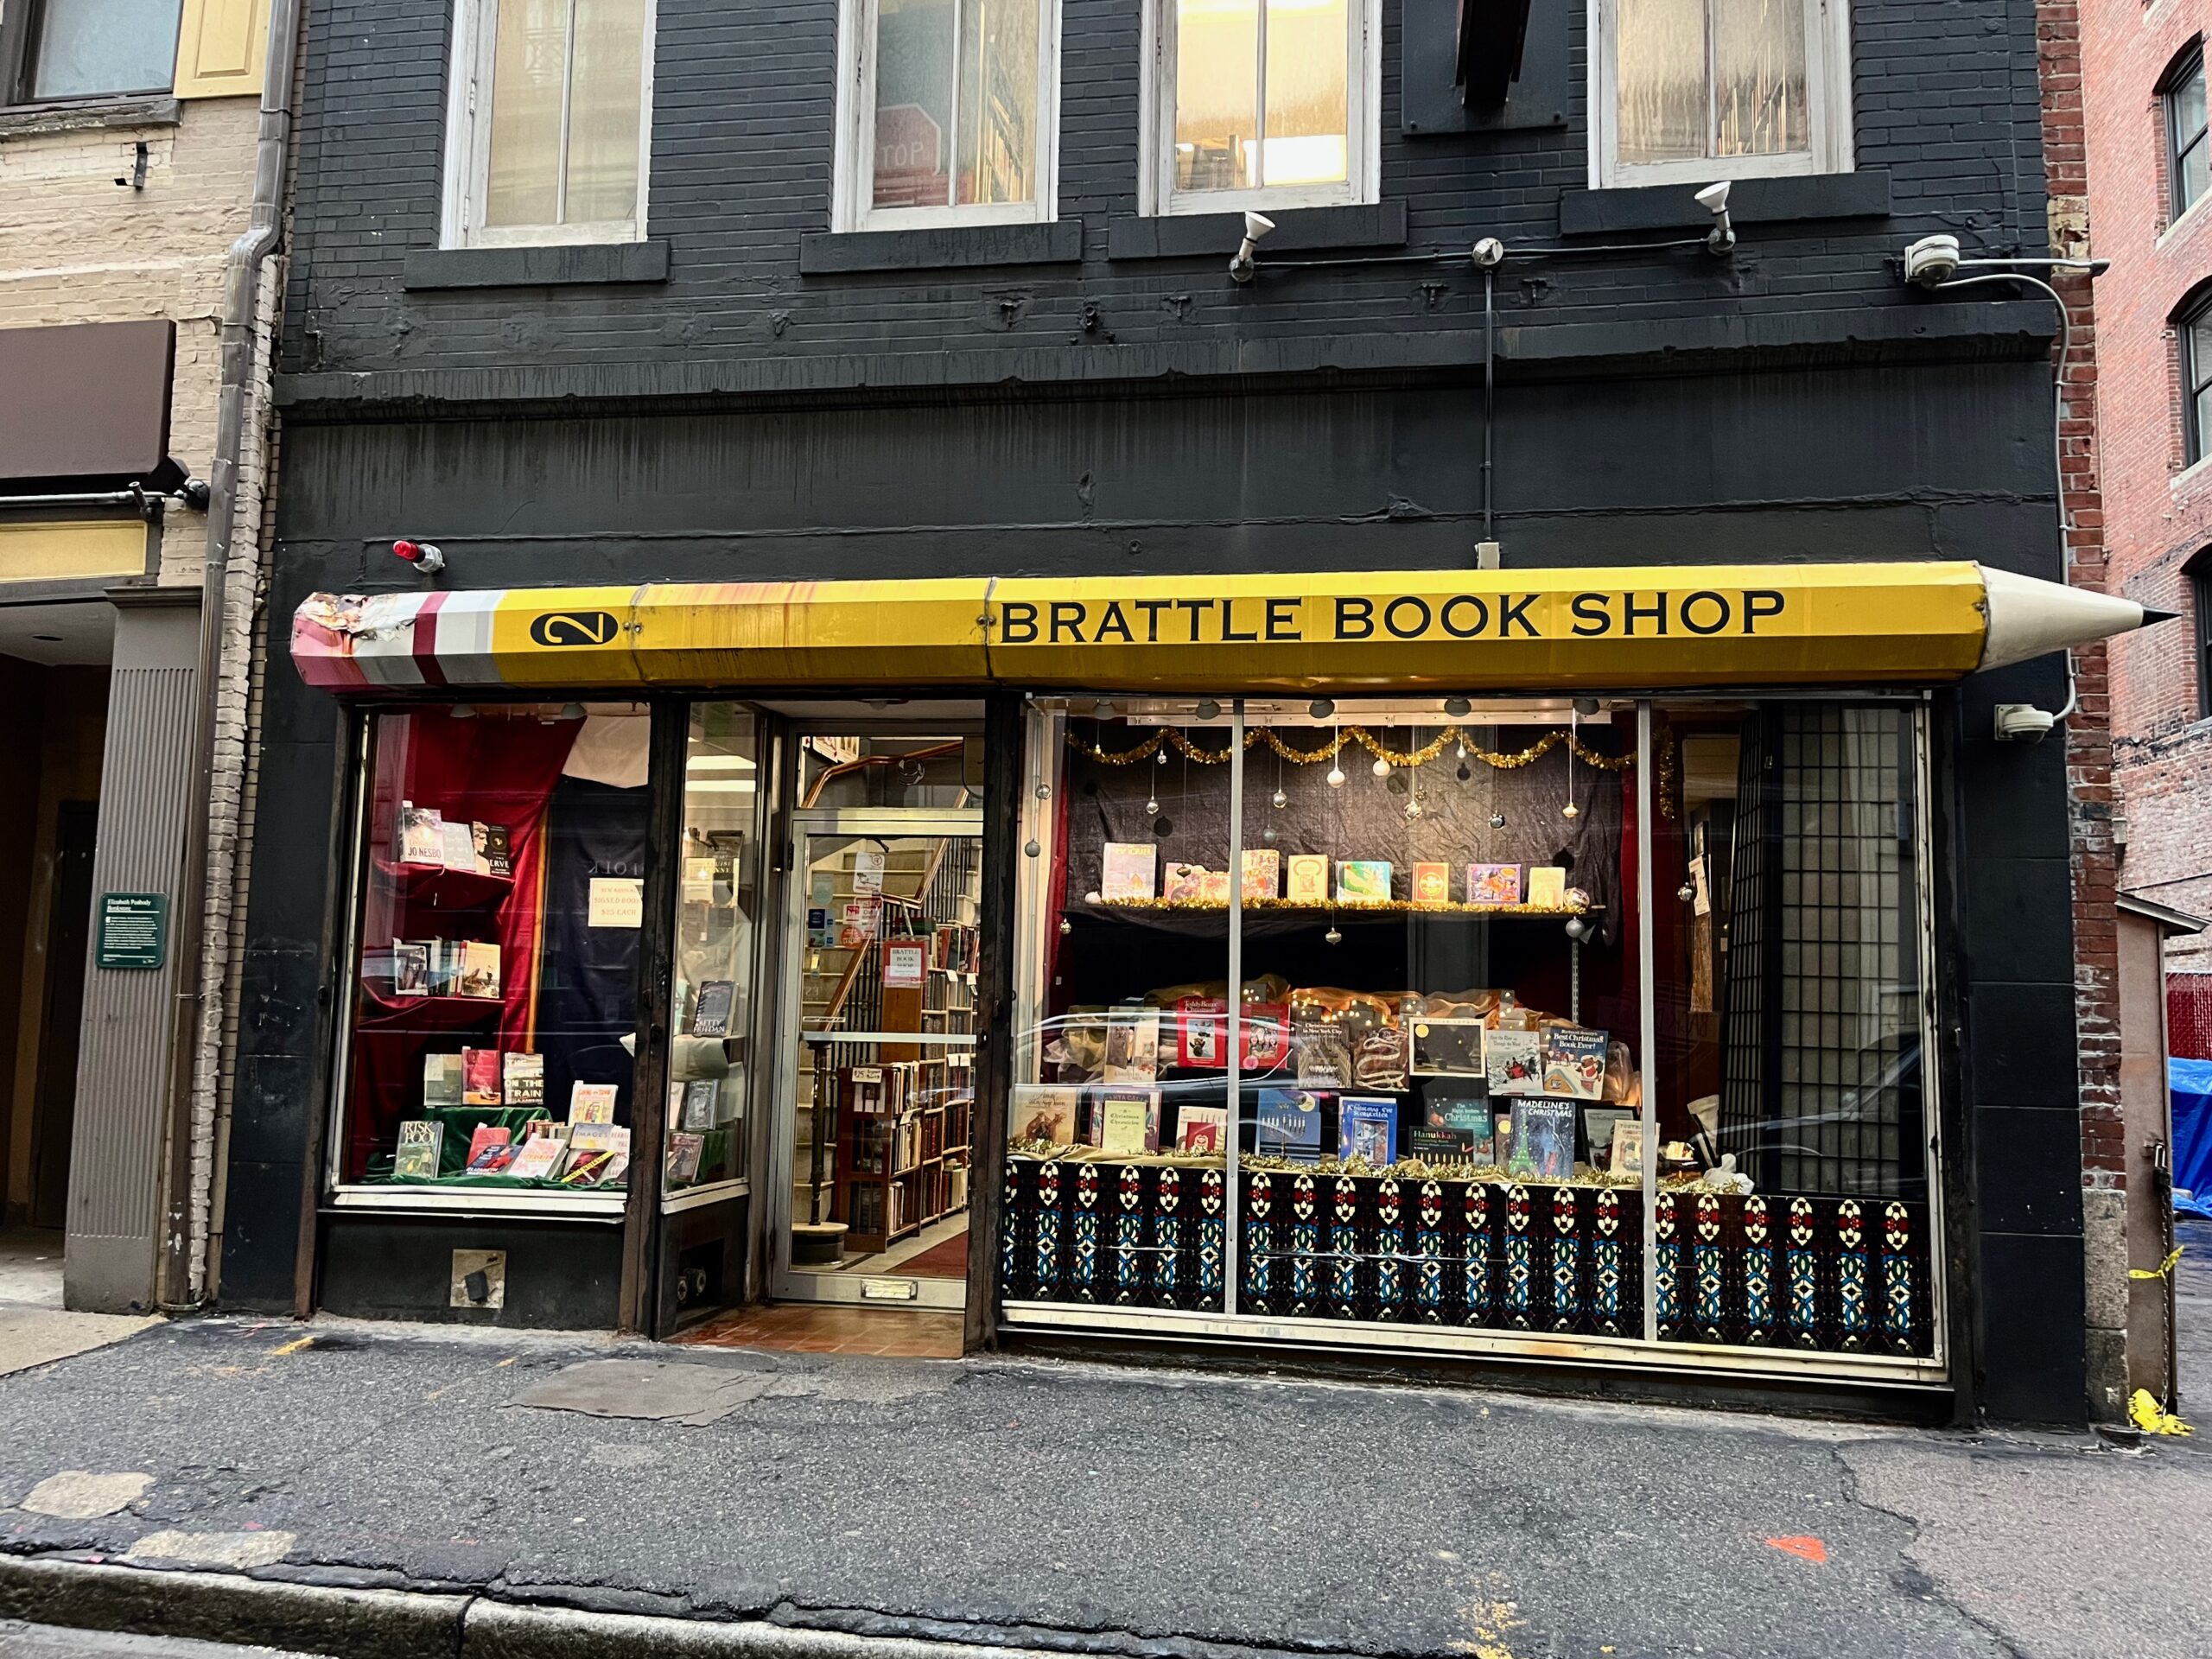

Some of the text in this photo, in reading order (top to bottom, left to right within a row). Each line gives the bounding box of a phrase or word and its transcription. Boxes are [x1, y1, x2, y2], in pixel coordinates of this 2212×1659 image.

[874, 141, 924, 169] TOP
[1001, 589, 1785, 644] BRATTLE BOOK SHOP
[543, 613, 604, 644] 2
[408, 847, 417, 856] JO
[1568, 1034, 1604, 1043] Christmas
[1577, 1041, 1596, 1050] Ever!
[507, 1089, 542, 1097] TRAIN
[1517, 1099, 1570, 1110] MADELINE'S
[1444, 1112, 1488, 1122] Christmas
[1528, 1108, 1573, 1118] CHRISTMAS
[404, 1121, 433, 1134] RISK
[404, 1132, 435, 1144] POOL
[1414, 1129, 1457, 1140] Hanukkah
